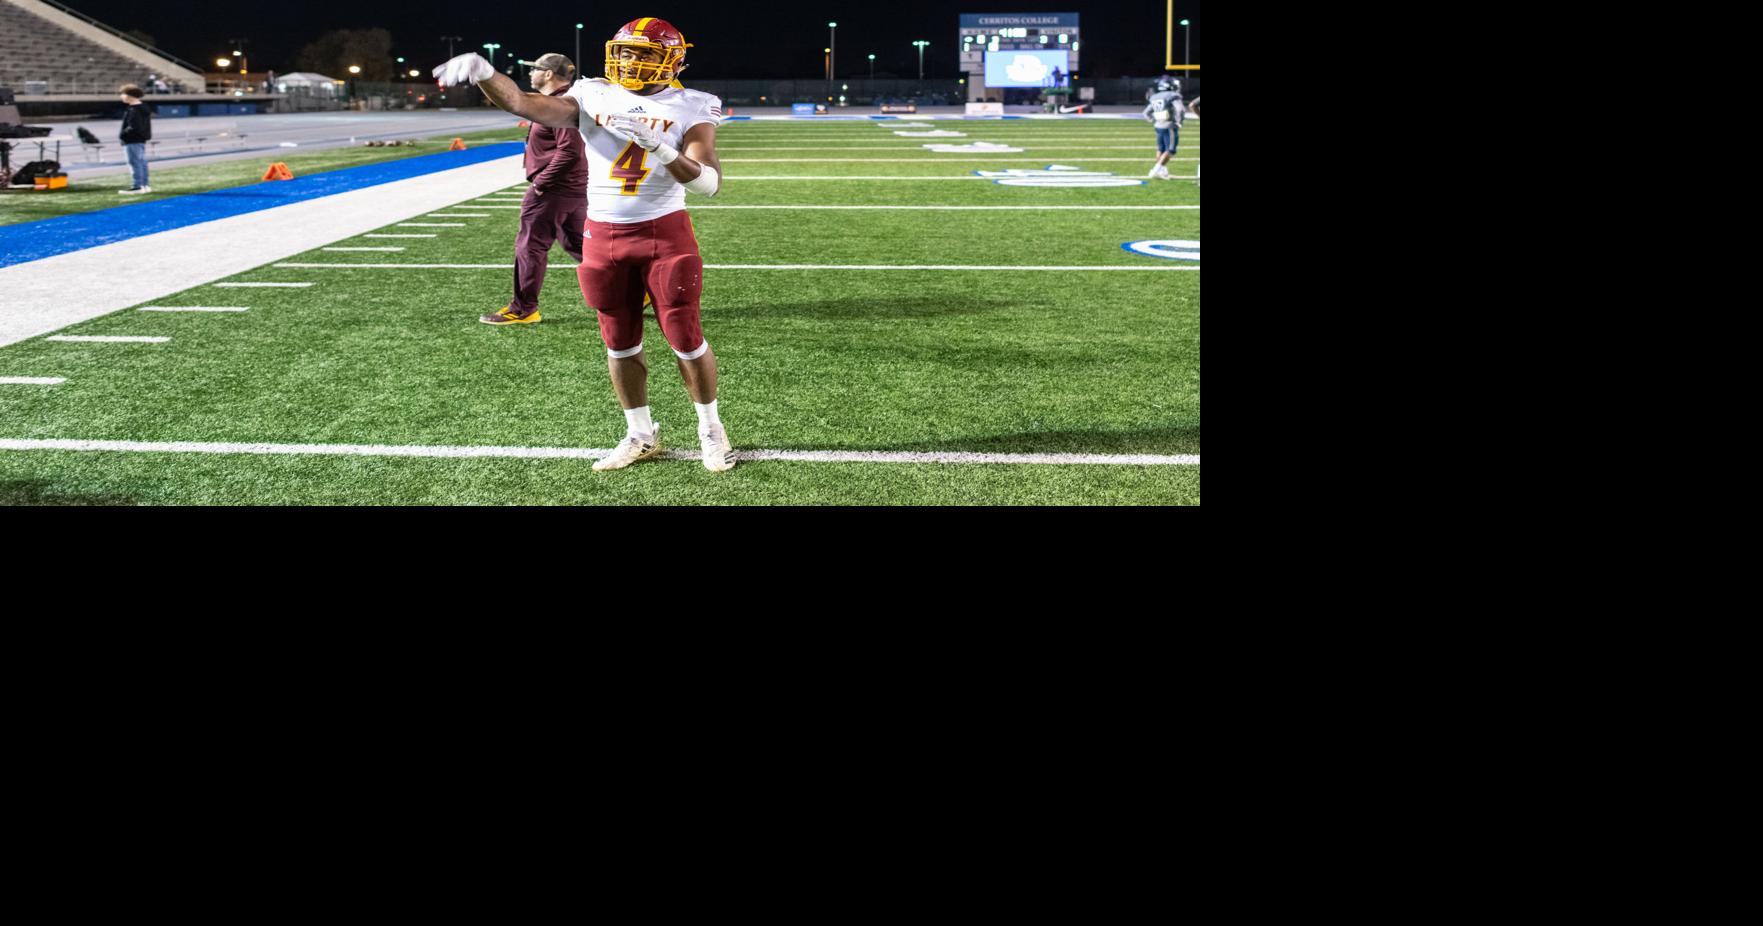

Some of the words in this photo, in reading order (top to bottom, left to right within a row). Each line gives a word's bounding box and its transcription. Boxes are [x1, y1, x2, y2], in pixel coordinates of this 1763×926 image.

[979, 16, 1020, 25] CERRITOS
[1020, 16, 1059, 25] COLLEGE
[610, 139, 651, 196] 4
